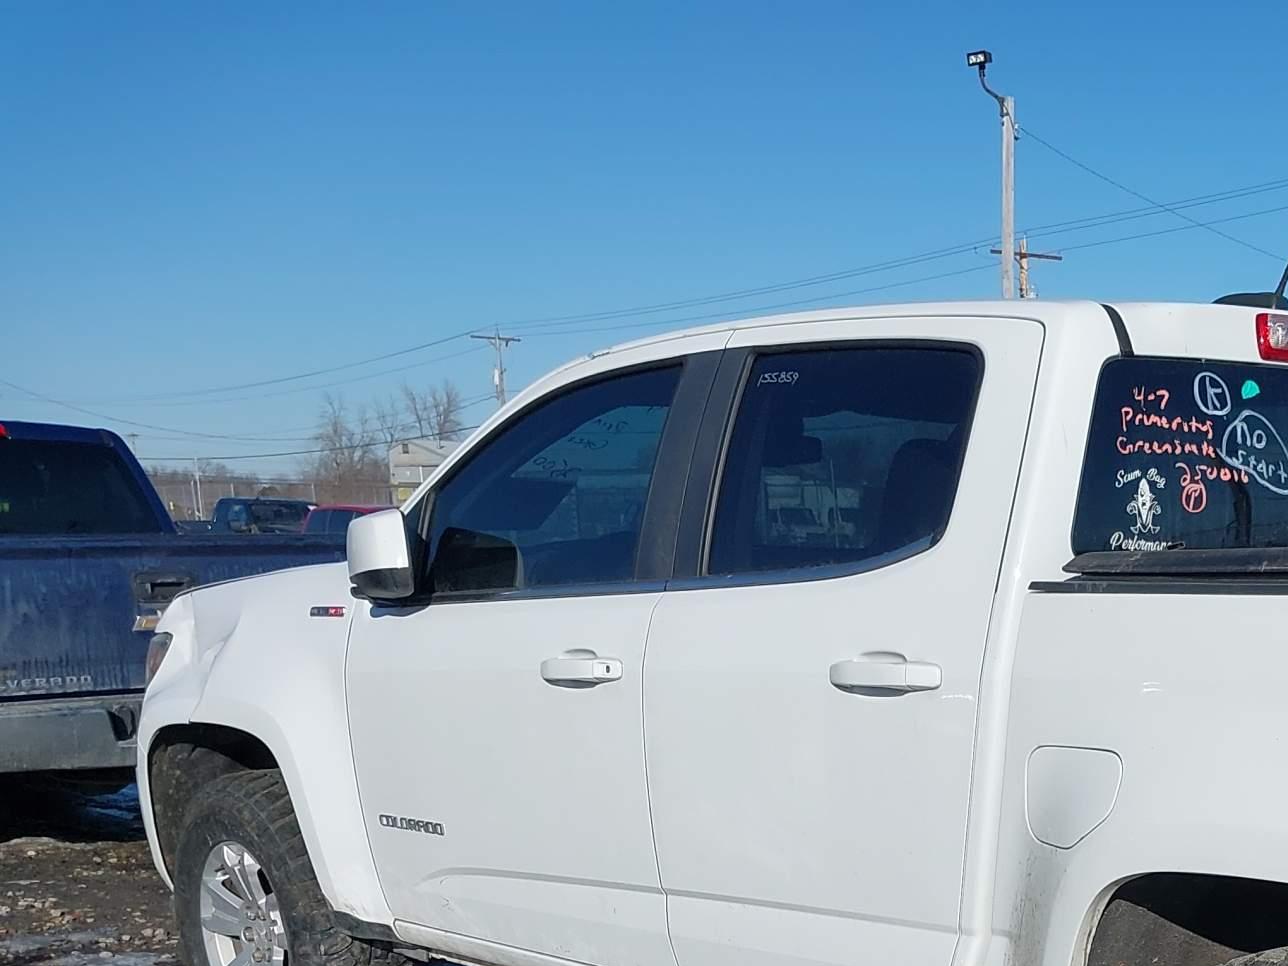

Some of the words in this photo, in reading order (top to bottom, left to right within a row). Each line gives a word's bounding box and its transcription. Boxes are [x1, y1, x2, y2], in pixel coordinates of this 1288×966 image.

[1146, 467, 1166, 489] Bag
[1109, 531, 1174, 552] Performan
[0, 676, 92, 690] VERADO
[379, 814, 445, 836] COLORADO
